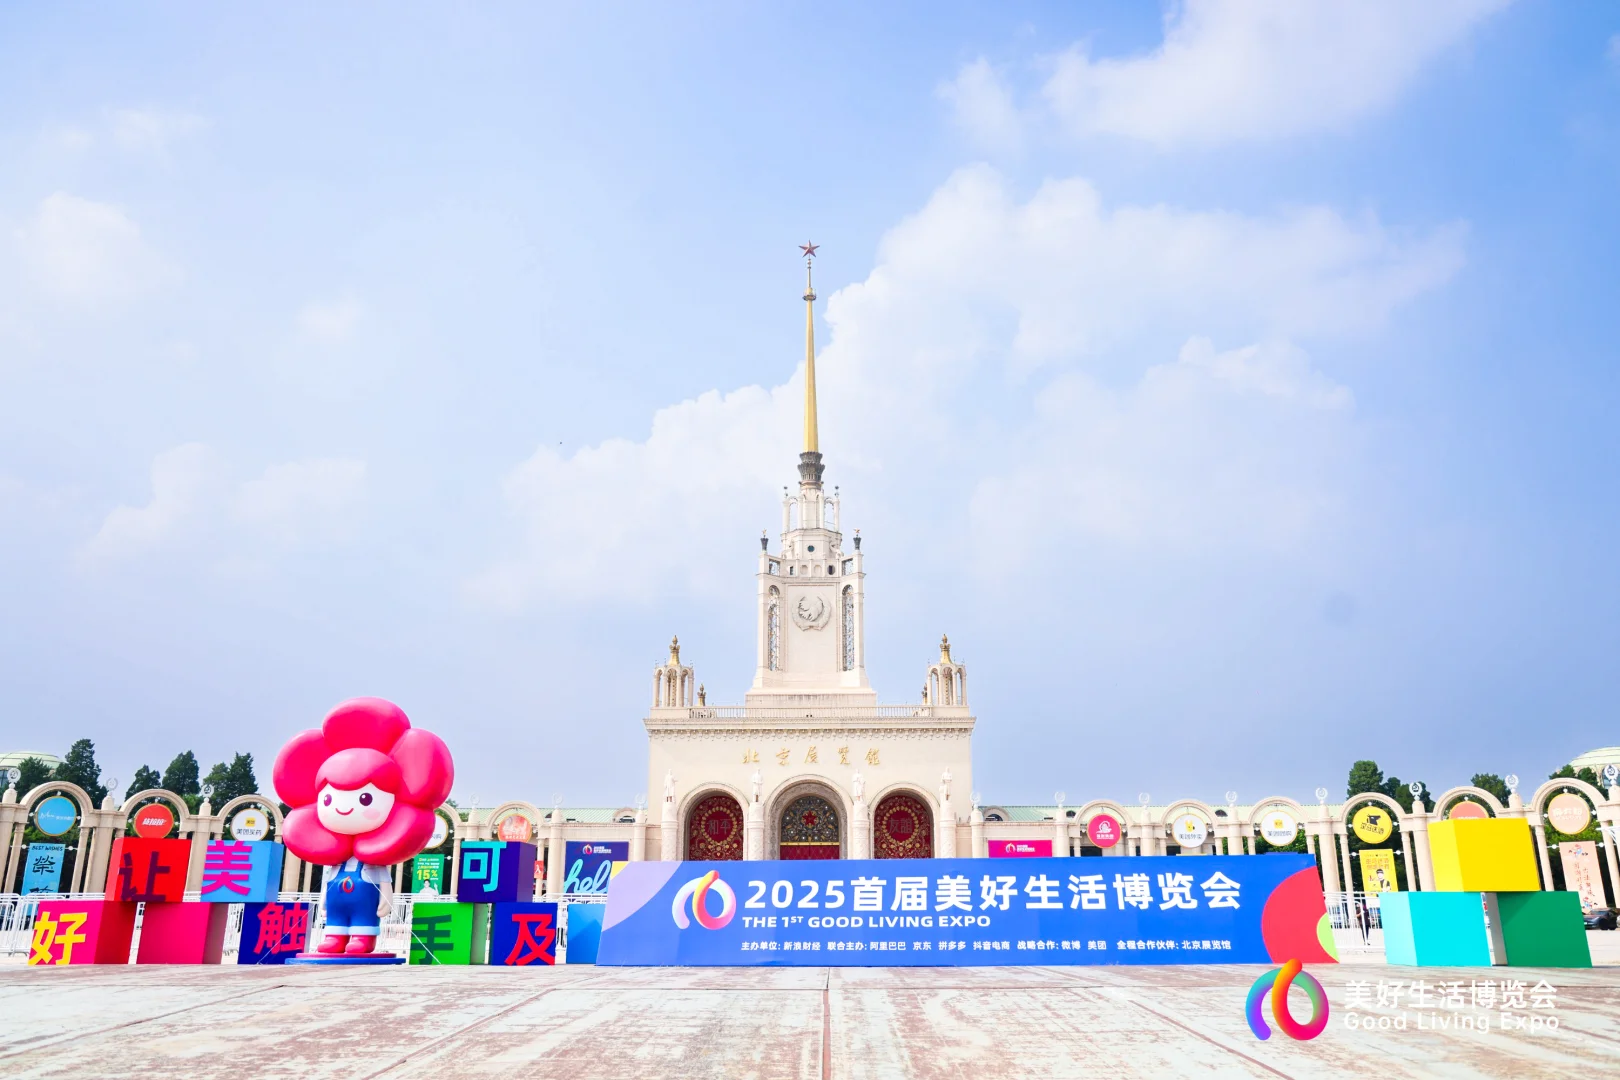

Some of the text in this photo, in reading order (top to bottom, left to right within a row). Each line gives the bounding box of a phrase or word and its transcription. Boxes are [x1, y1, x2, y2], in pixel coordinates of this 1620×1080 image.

[706, 817, 732, 835] 和平
[118, 851, 171, 902] 让
[201, 839, 253, 896] 美
[460, 841, 507, 892] 可
[564, 858, 612, 894] hel
[746, 871, 1241, 912] 2025首届美好生活博览会
[28, 911, 88, 966] 好
[253, 902, 309, 955] 触
[410, 914, 455, 965] 手
[505, 913, 556, 966] 及
[742, 915, 991, 928] THE 1ST GOOD LIVING EXPO
[912, 941, 932, 951] 京东
[938, 940, 967, 951] 拼多多
[972, 940, 1010, 951] 抖音电商
[1087, 940, 1107, 950] 美团
